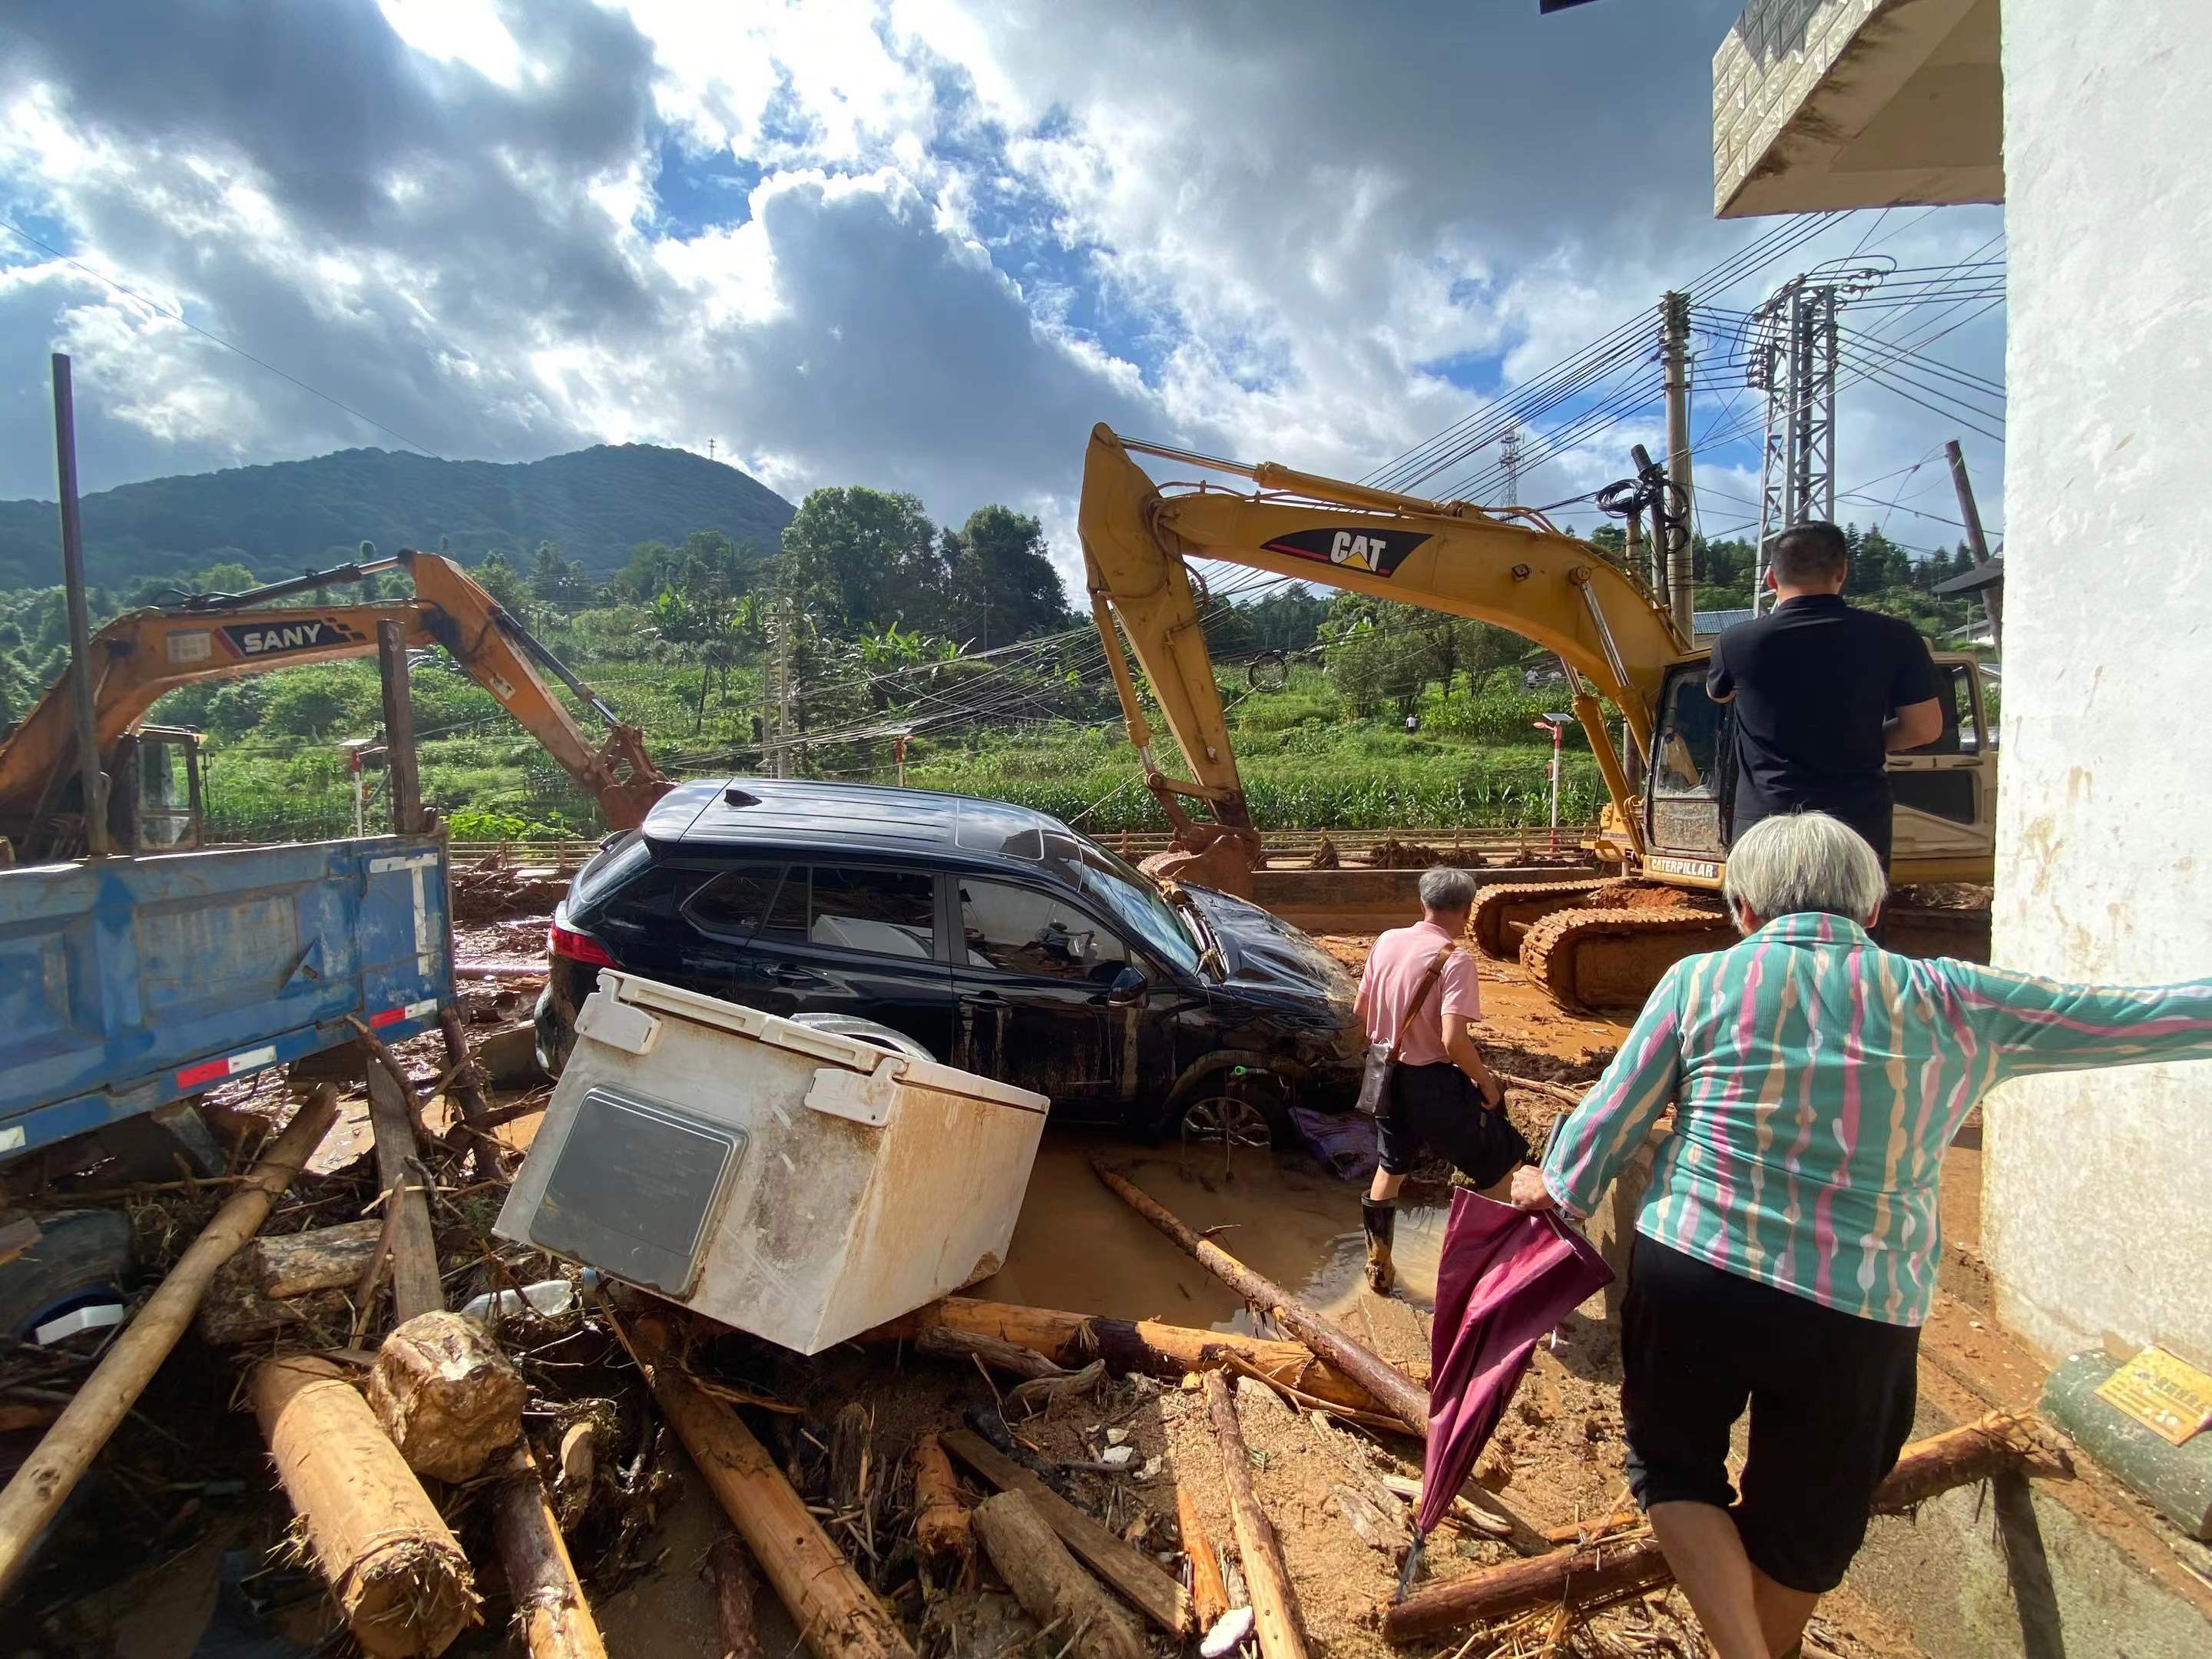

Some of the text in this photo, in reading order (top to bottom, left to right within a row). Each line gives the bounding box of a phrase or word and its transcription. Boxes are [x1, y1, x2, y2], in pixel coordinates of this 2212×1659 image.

[1330, 531, 1386, 572] CAT
[243, 623, 321, 653] SANY
[1651, 859, 1714, 878] CATERPILLAR
